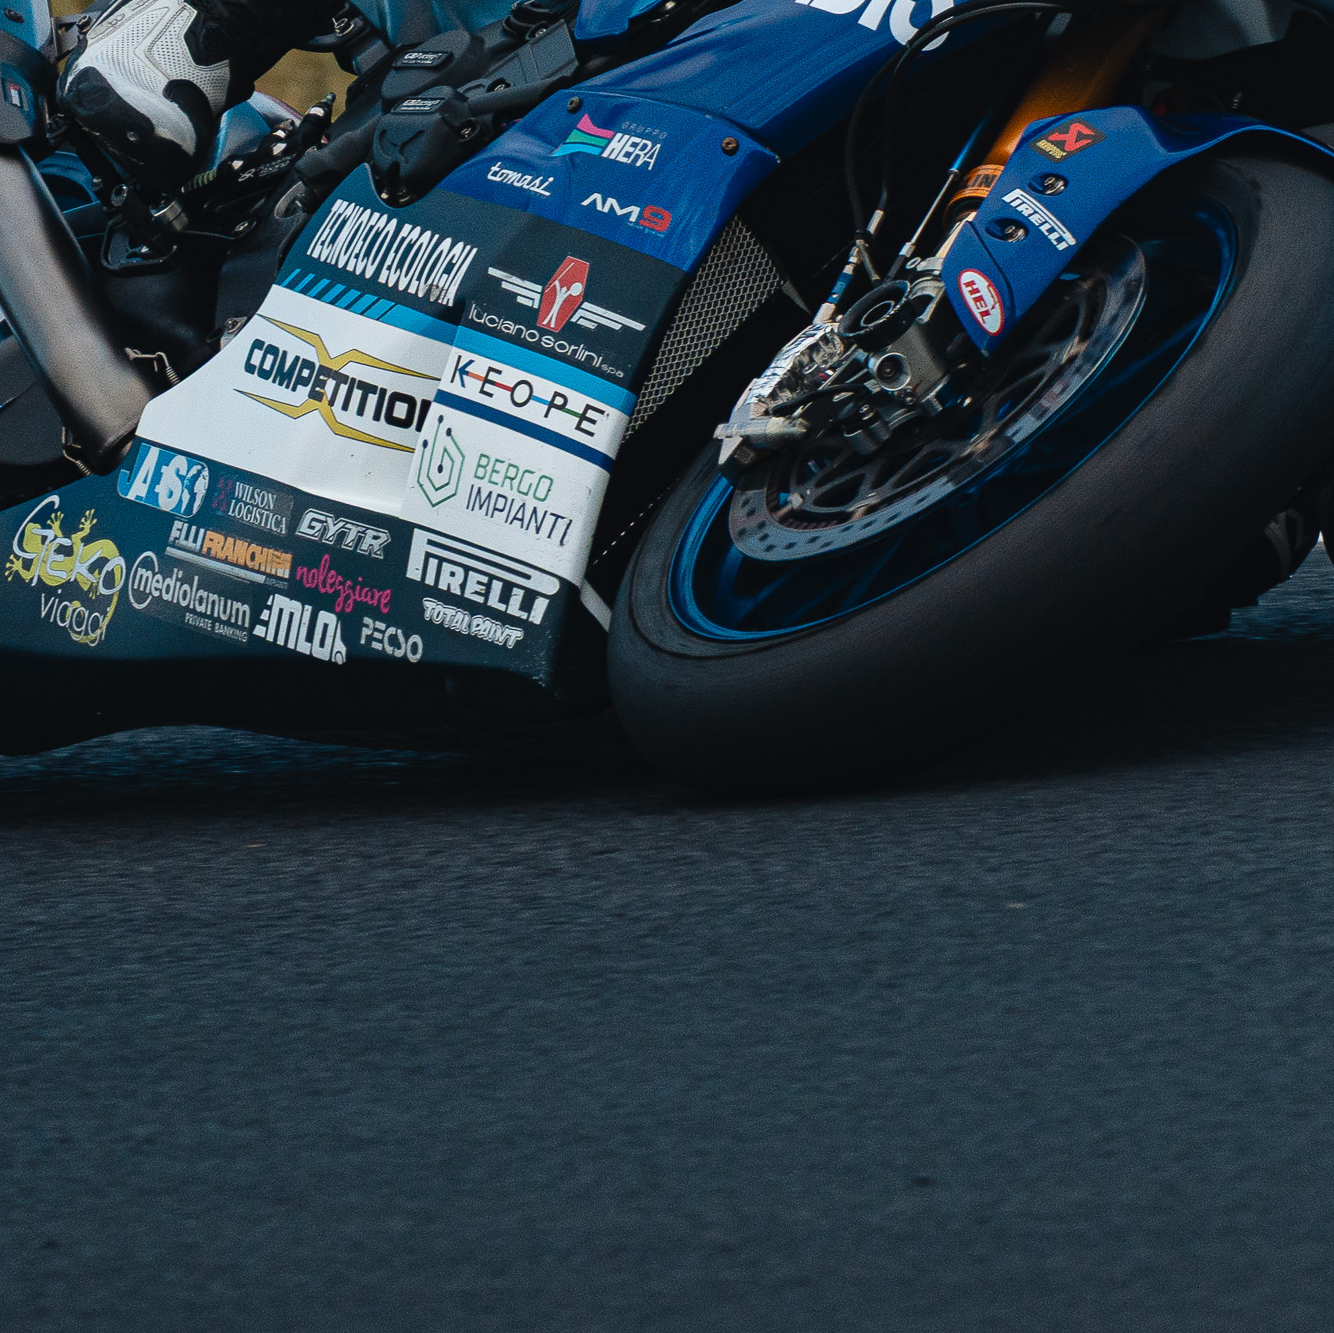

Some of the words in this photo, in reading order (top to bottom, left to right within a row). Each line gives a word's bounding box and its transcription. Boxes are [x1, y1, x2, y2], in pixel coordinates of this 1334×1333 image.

[487, 161, 555, 197] tomasi
[601, 132, 662, 171] HERA
[580, 192, 673, 233] AM9
[1001, 188, 1077, 251] PIRELLI
[306, 198, 398, 279] TECNOECO
[378, 223, 479, 307] ECOLOGIA
[962, 278, 991, 326] HEL
[468, 303, 540, 343] luciano
[541, 334, 604, 368] sorlini
[601, 362, 624, 379] spa
[450, 354, 607, 437] KEOPE
[234, 481, 277, 510] WILSON
[473, 453, 554, 503] BERGO
[228, 499, 287, 535] LOGISTICA
[295, 508, 391, 559] GYTR
[466, 484, 573, 547] IMPIANTI
[133, 565, 251, 628] mediolanum
[295, 553, 392, 614] noleggiare
[406, 527, 560, 625] PIRELLI
[40, 588, 111, 647] viaggi
[184, 611, 213, 632] PRIVATE
[213, 621, 249, 643] BANKING
